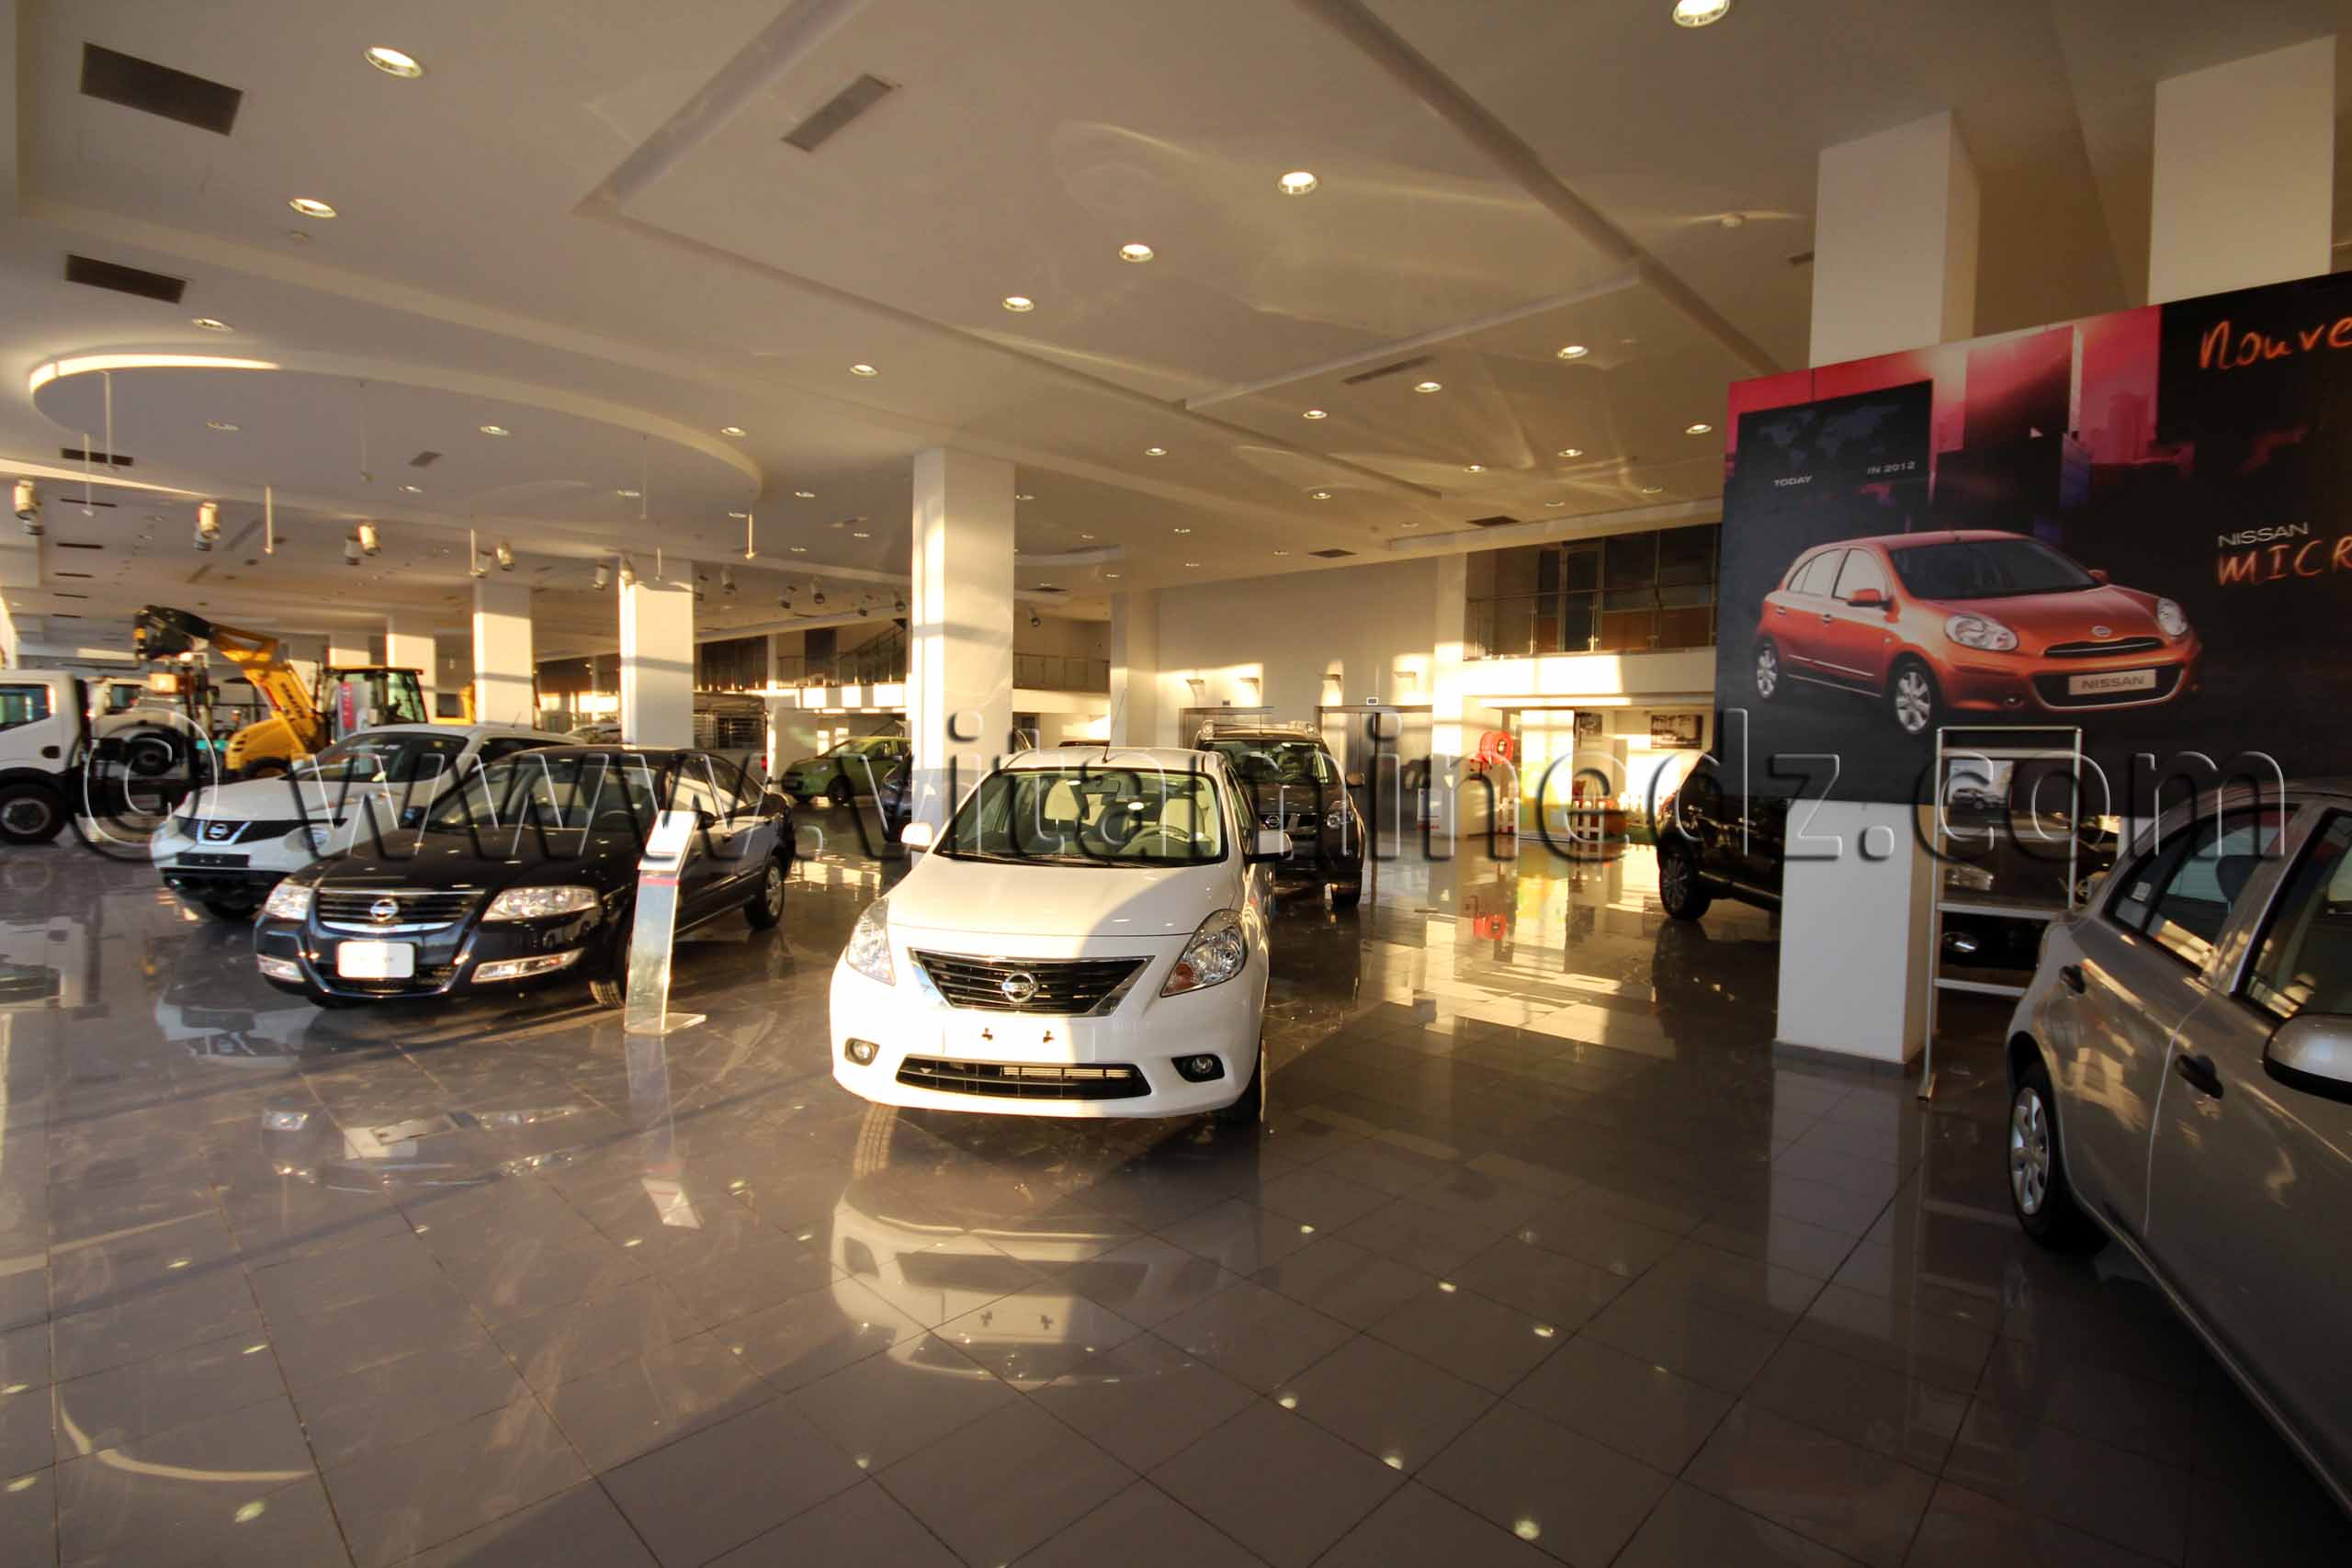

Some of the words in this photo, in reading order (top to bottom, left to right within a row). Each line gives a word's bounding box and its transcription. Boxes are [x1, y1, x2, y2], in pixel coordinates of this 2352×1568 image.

[1867, 466, 1882, 475] IN
[1883, 461, 1917, 473] 2012
[1773, 474, 1813, 487] TODAY
[2219, 522, 2309, 547] NISSAN
[2081, 675, 2145, 689] NISSAN
